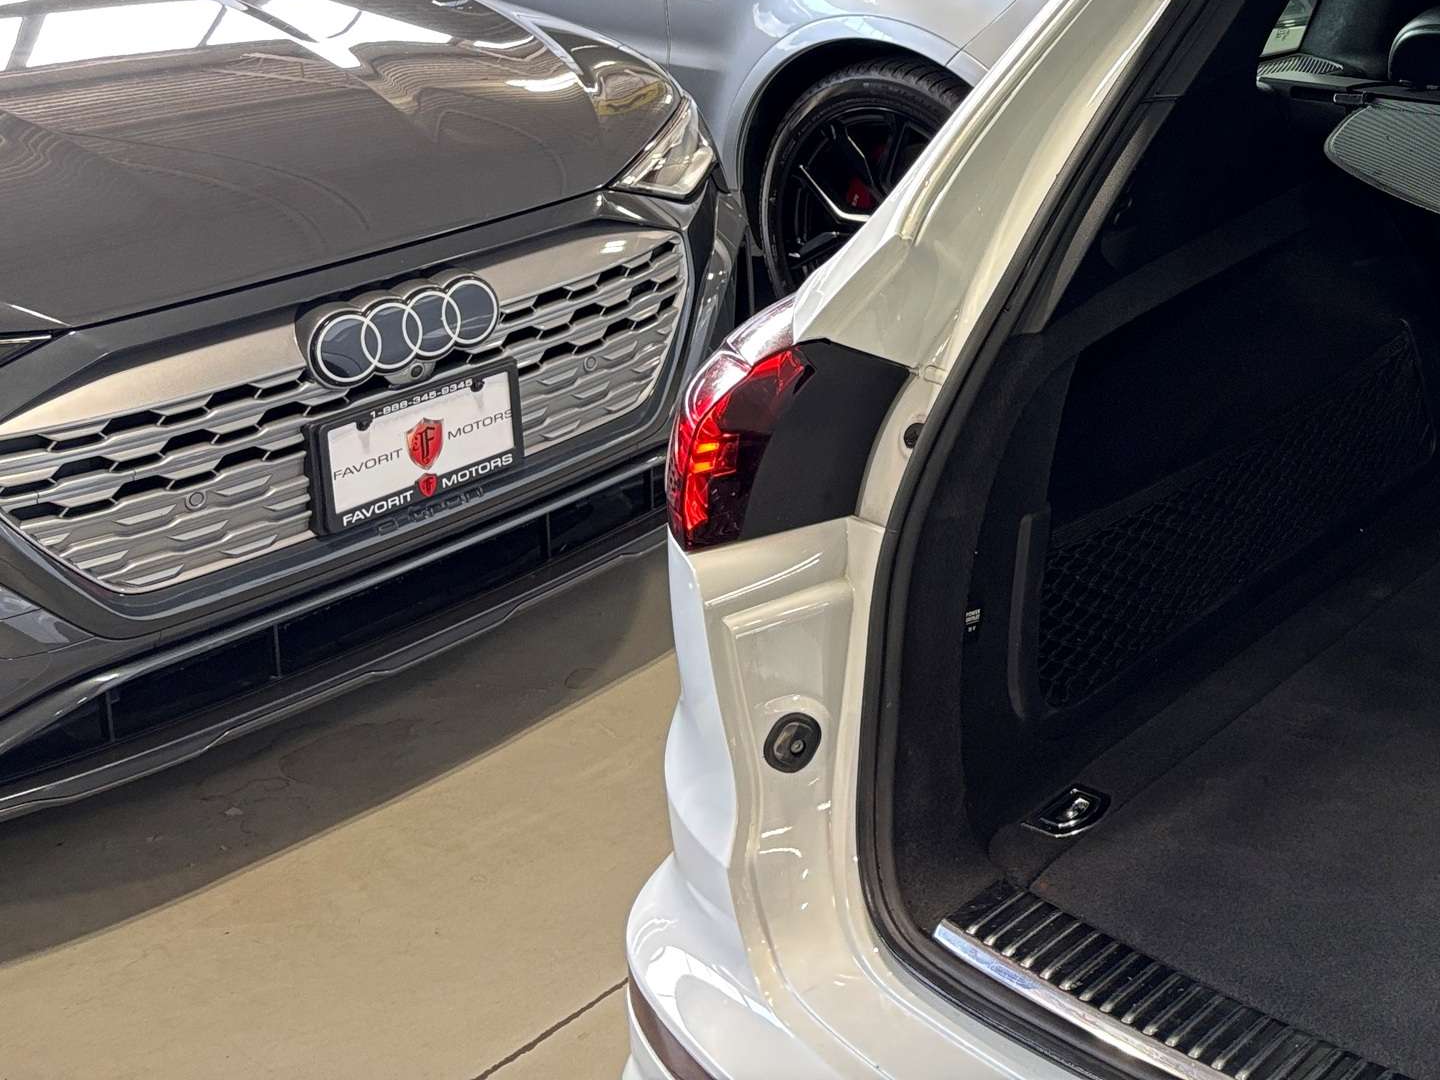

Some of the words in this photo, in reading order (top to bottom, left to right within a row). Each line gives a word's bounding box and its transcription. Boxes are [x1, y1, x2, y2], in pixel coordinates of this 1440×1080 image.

[333, 448, 403, 481] FAVORIT
[447, 409, 513, 440] MOTORS
[342, 490, 414, 527] FAVORIT
[442, 453, 513, 489] MOTORS
